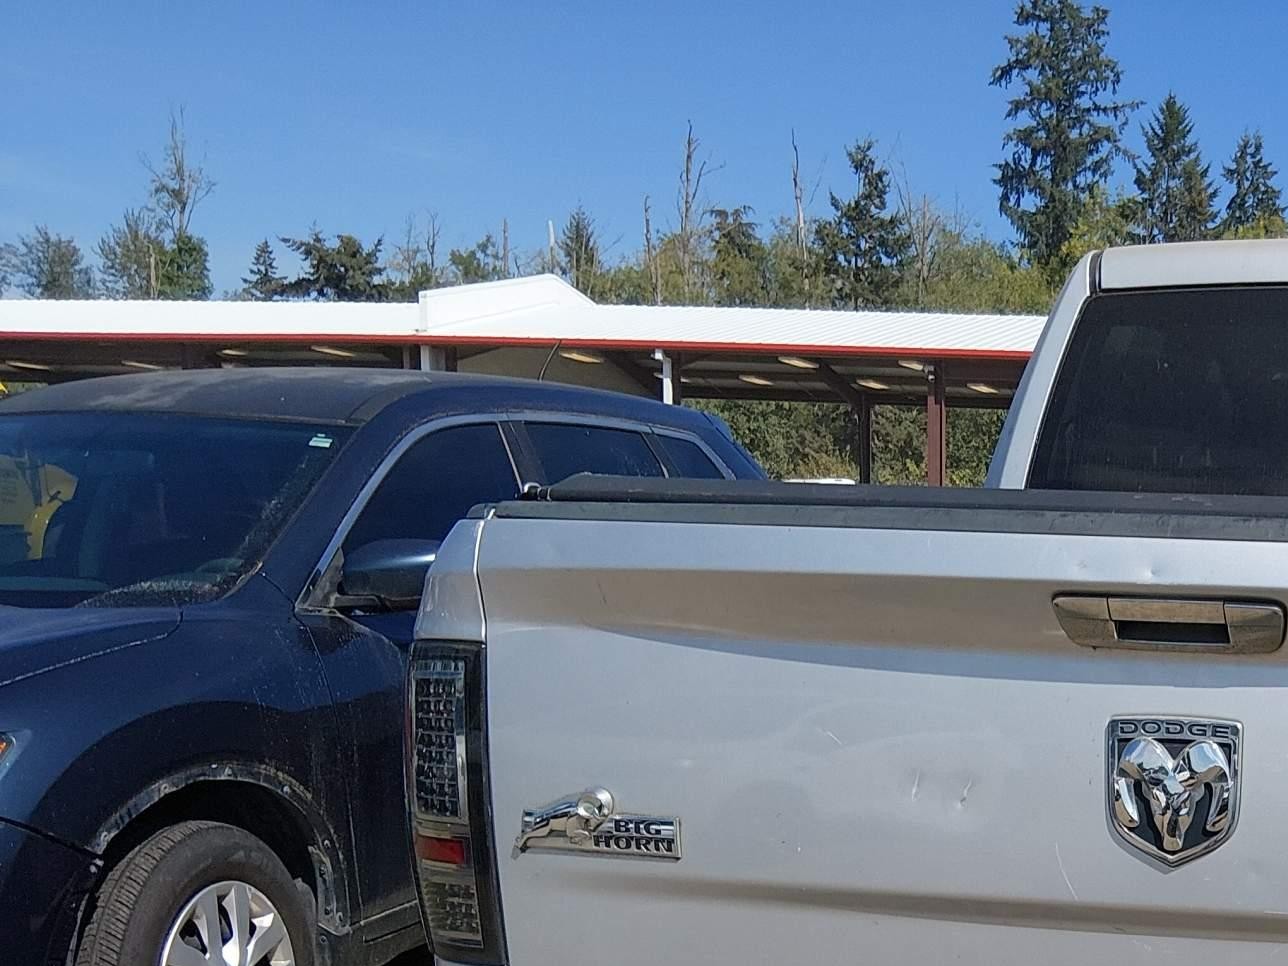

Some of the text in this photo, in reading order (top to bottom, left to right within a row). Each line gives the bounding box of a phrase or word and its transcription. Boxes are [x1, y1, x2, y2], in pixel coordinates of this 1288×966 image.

[1119, 720, 1231, 739] DODGE
[613, 818, 662, 836] BIG
[592, 834, 675, 853] HORN
